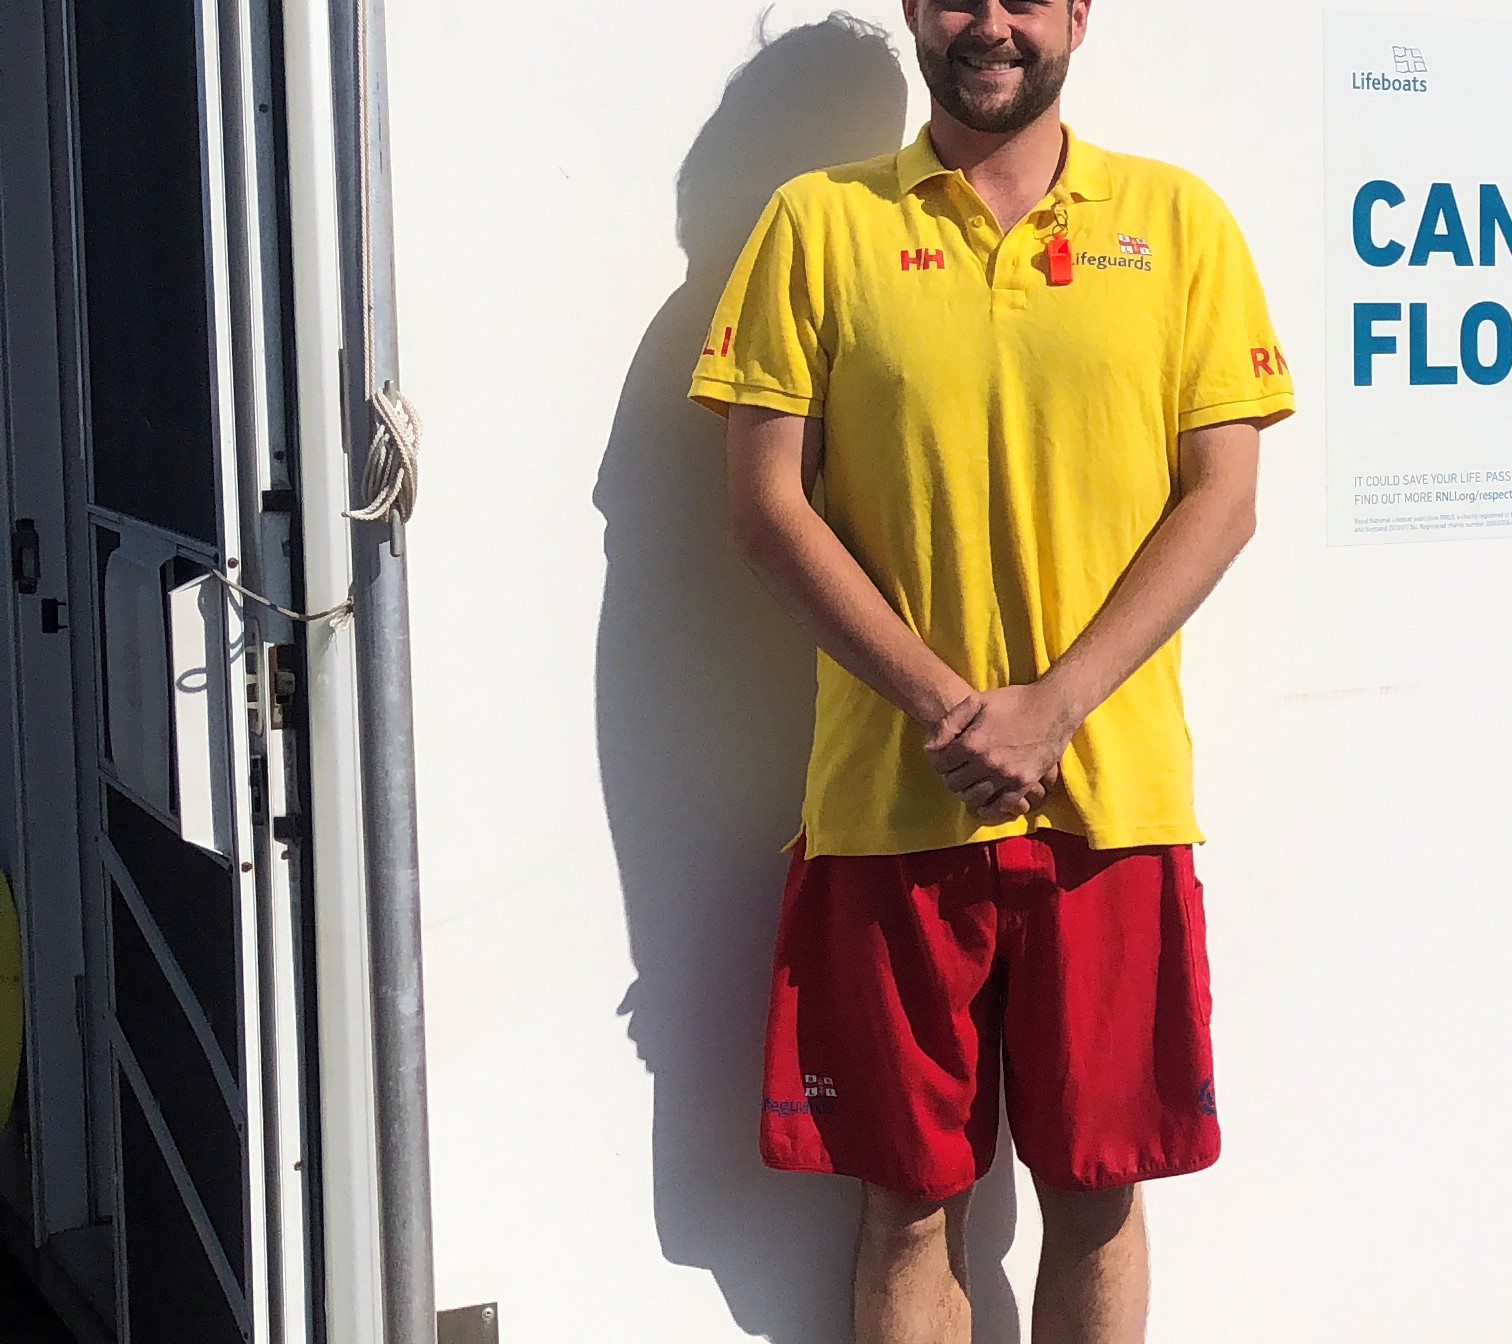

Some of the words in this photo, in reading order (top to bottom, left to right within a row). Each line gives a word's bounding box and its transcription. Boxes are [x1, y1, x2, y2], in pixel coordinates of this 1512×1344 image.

[1352, 71, 1428, 93] Lifeboats
[900, 247, 946, 272] HH
[1071, 252, 1153, 272] ifeguards
[1354, 476, 1364, 488] IT
[1365, 474, 1401, 487] COULD
[1402, 473, 1429, 486] SAVE
[1430, 472, 1458, 485] YOUR
[1486, 470, 1512, 483] PASS
[1354, 493, 1379, 506] FIND
[1381, 492, 1402, 505] OUT
[1404, 491, 1434, 504] MORE
